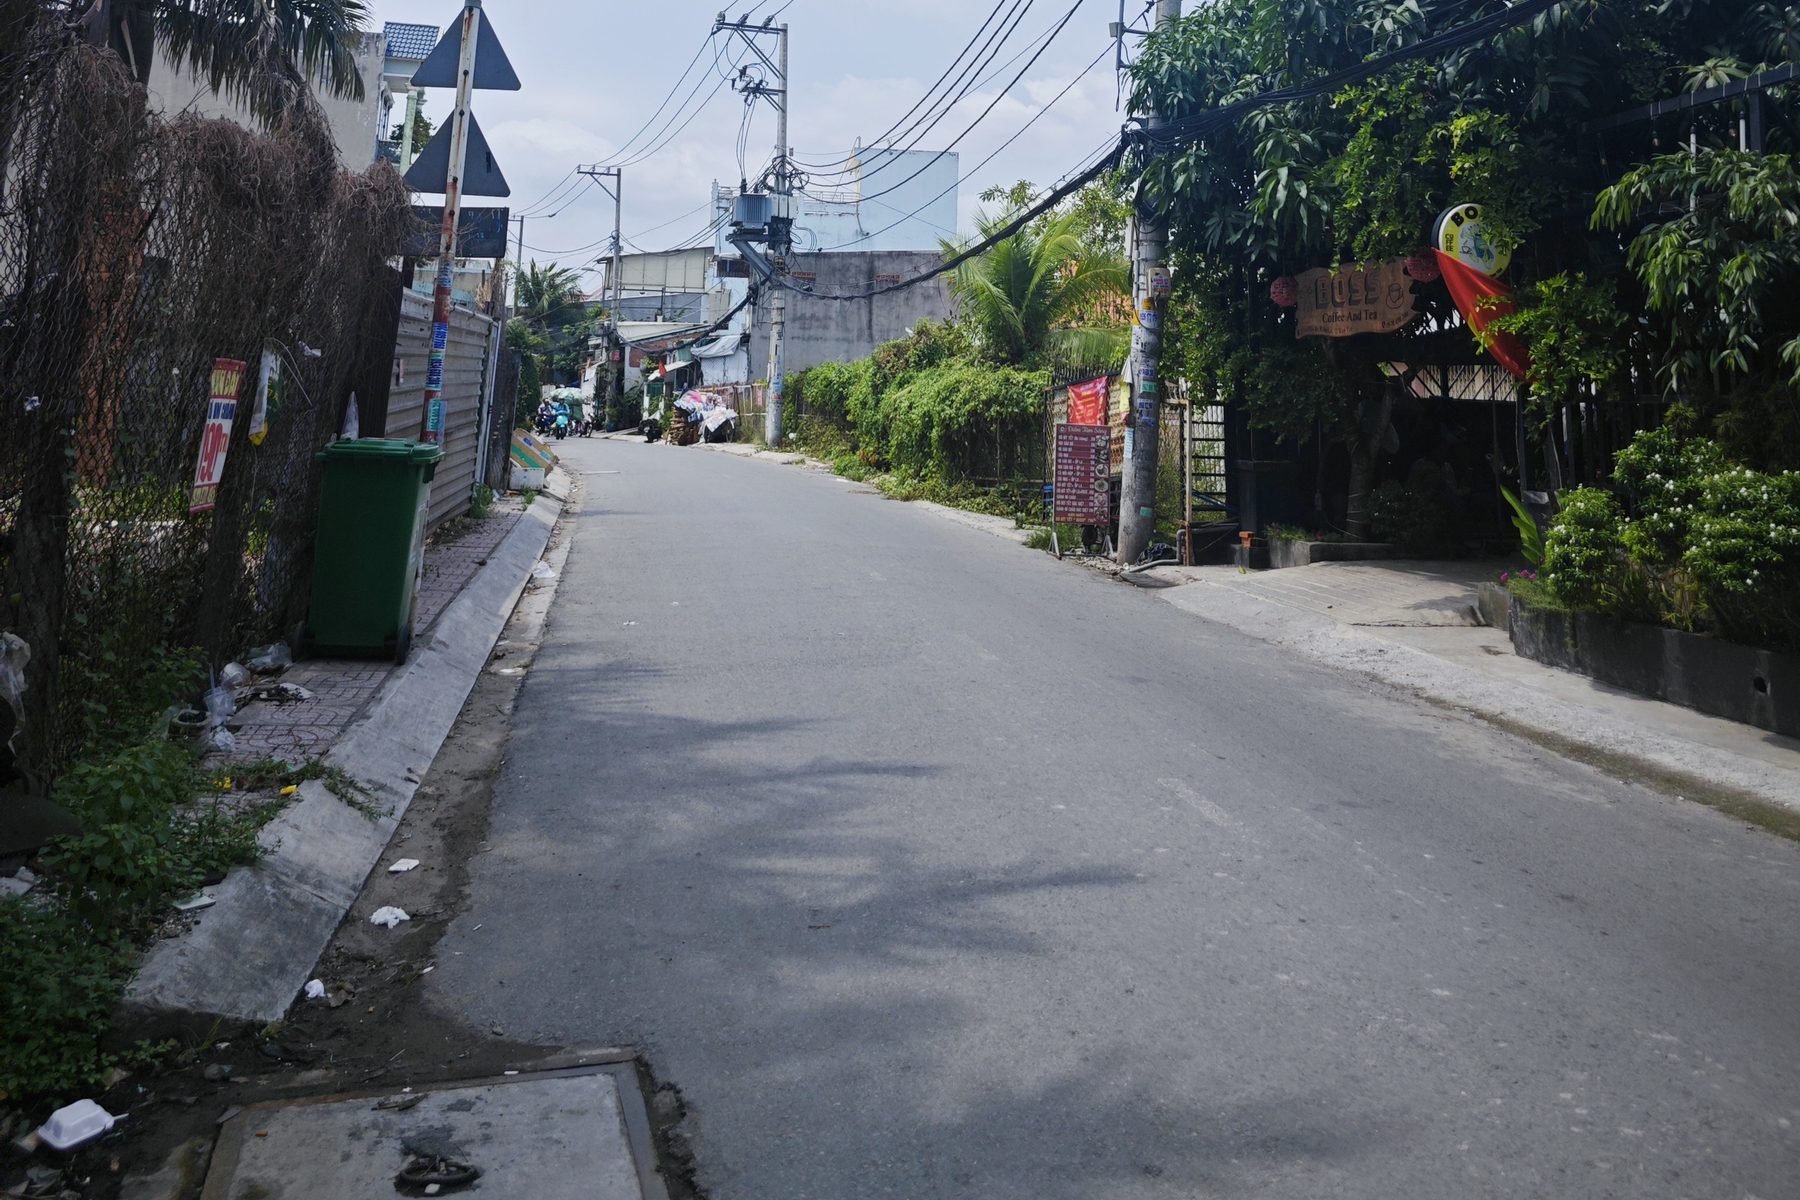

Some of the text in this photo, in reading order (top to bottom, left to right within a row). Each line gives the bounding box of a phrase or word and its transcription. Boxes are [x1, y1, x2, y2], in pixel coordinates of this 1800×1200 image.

[1322, 311, 1345, 323] Coffee
[1347, 310, 1361, 321] And
[1364, 309, 1378, 320] Tea
